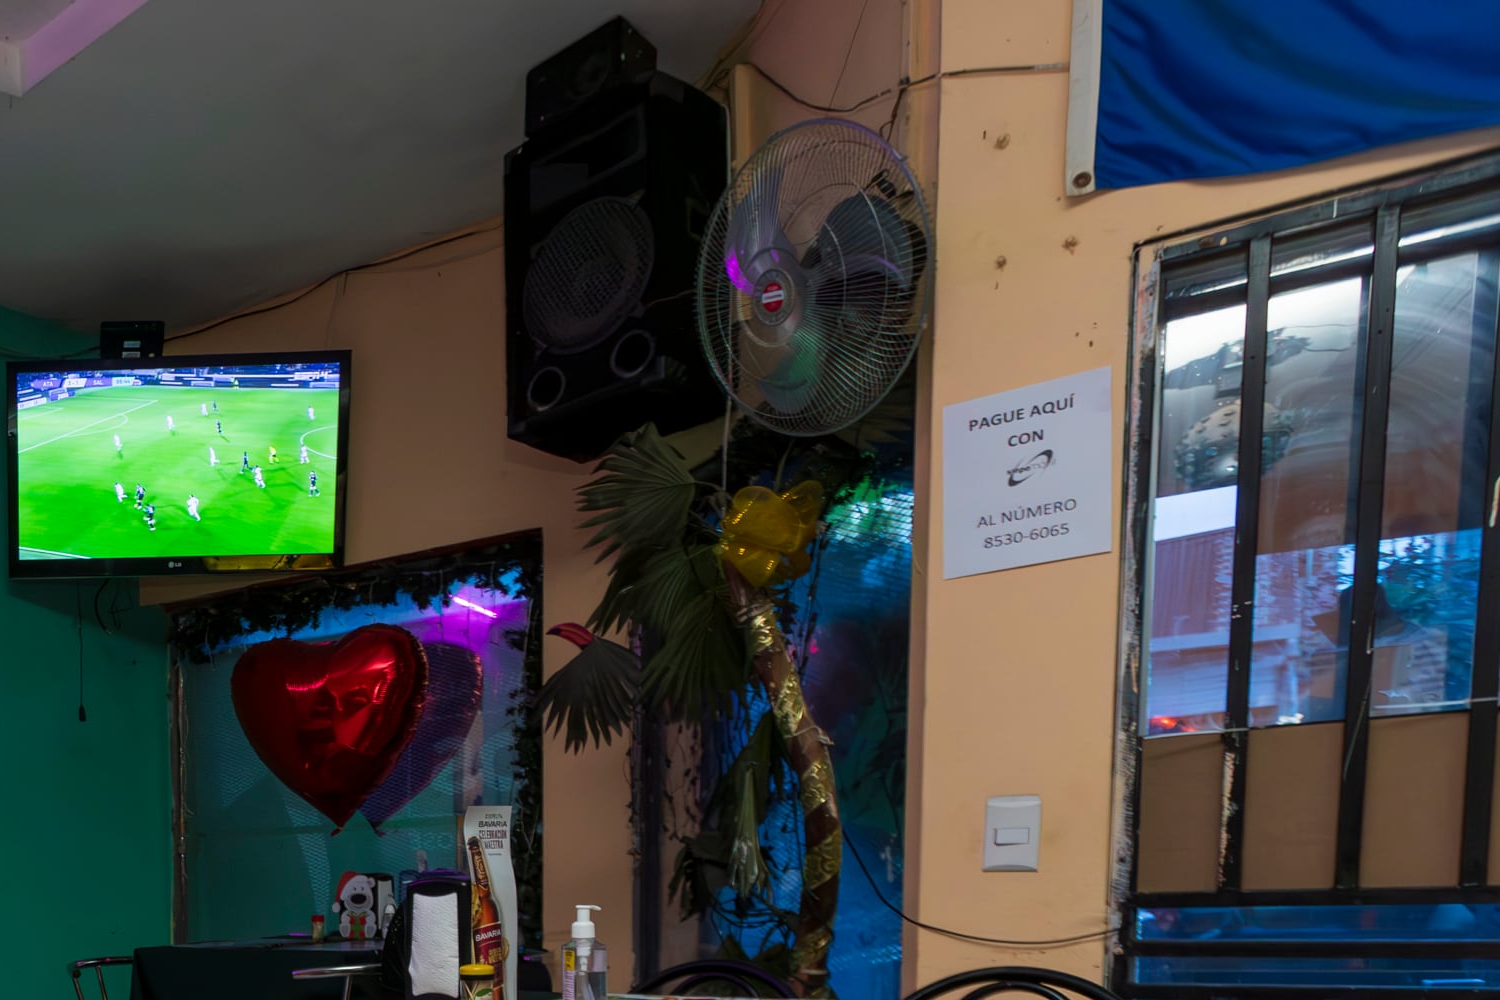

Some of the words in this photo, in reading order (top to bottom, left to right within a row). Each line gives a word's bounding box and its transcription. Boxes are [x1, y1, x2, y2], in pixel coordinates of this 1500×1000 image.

[969, 408, 1025, 431] PAGUE
[1030, 393, 1075, 417] AQUÍ
[1008, 429, 1044, 447] CON
[977, 515, 997, 529] AL
[1001, 498, 1077, 525] NÚMERO
[984, 523, 1070, 549] 8530-6065
